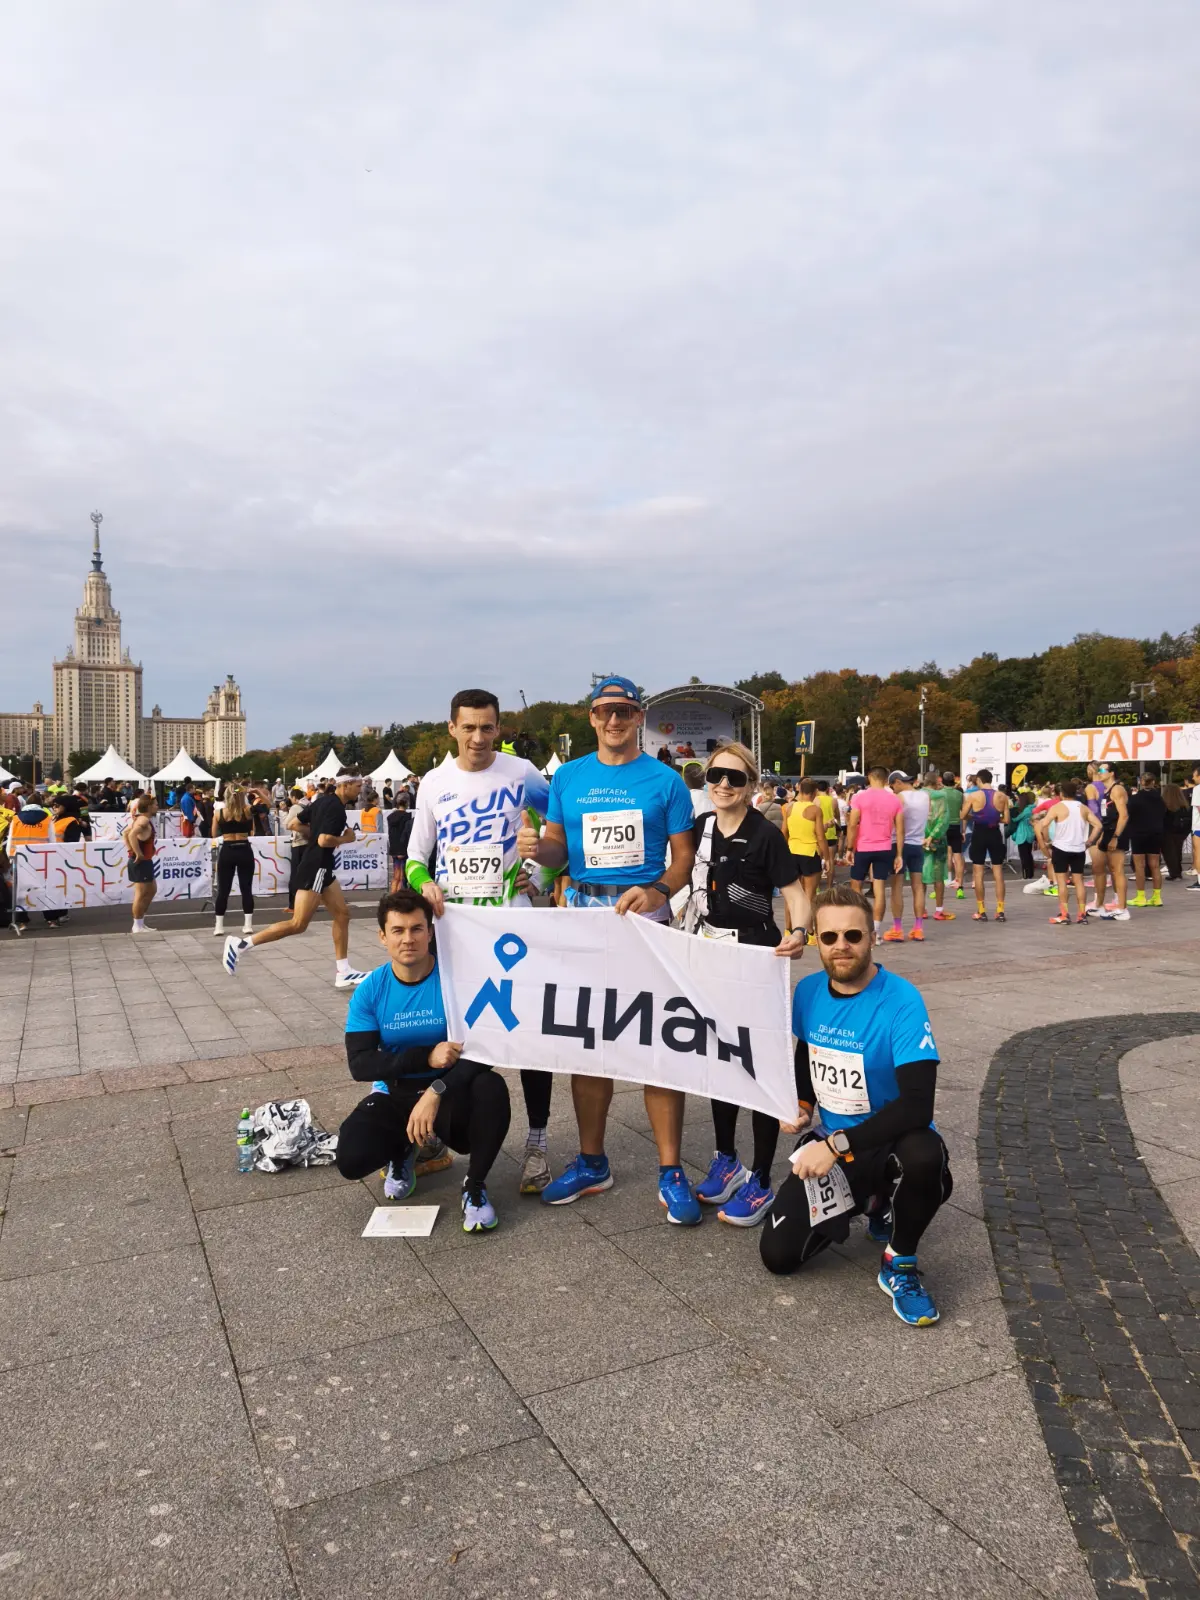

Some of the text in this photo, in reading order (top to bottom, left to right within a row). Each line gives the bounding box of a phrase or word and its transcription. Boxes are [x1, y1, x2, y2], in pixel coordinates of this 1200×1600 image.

[1055, 725, 1183, 761] СТАРТ
[588, 788, 627, 796] ДВИГАЕМ
[576, 797, 636, 805] НЕДВИЖИМОЕ
[591, 824, 636, 844] 7750
[343, 859, 379, 870] BRICS
[449, 857, 502, 874] 16579
[590, 856, 598, 866] G
[163, 866, 202, 880] BRICS
[393, 1009, 433, 1021] ДВИГАЕМ
[383, 1017, 444, 1030] НЕДВИЖИМОЕ
[817, 1024, 855, 1039] ДВИГАЕМ
[809, 1030, 865, 1051] НЕДВИЖИМОЕ
[811, 1060, 864, 1090] 17312
